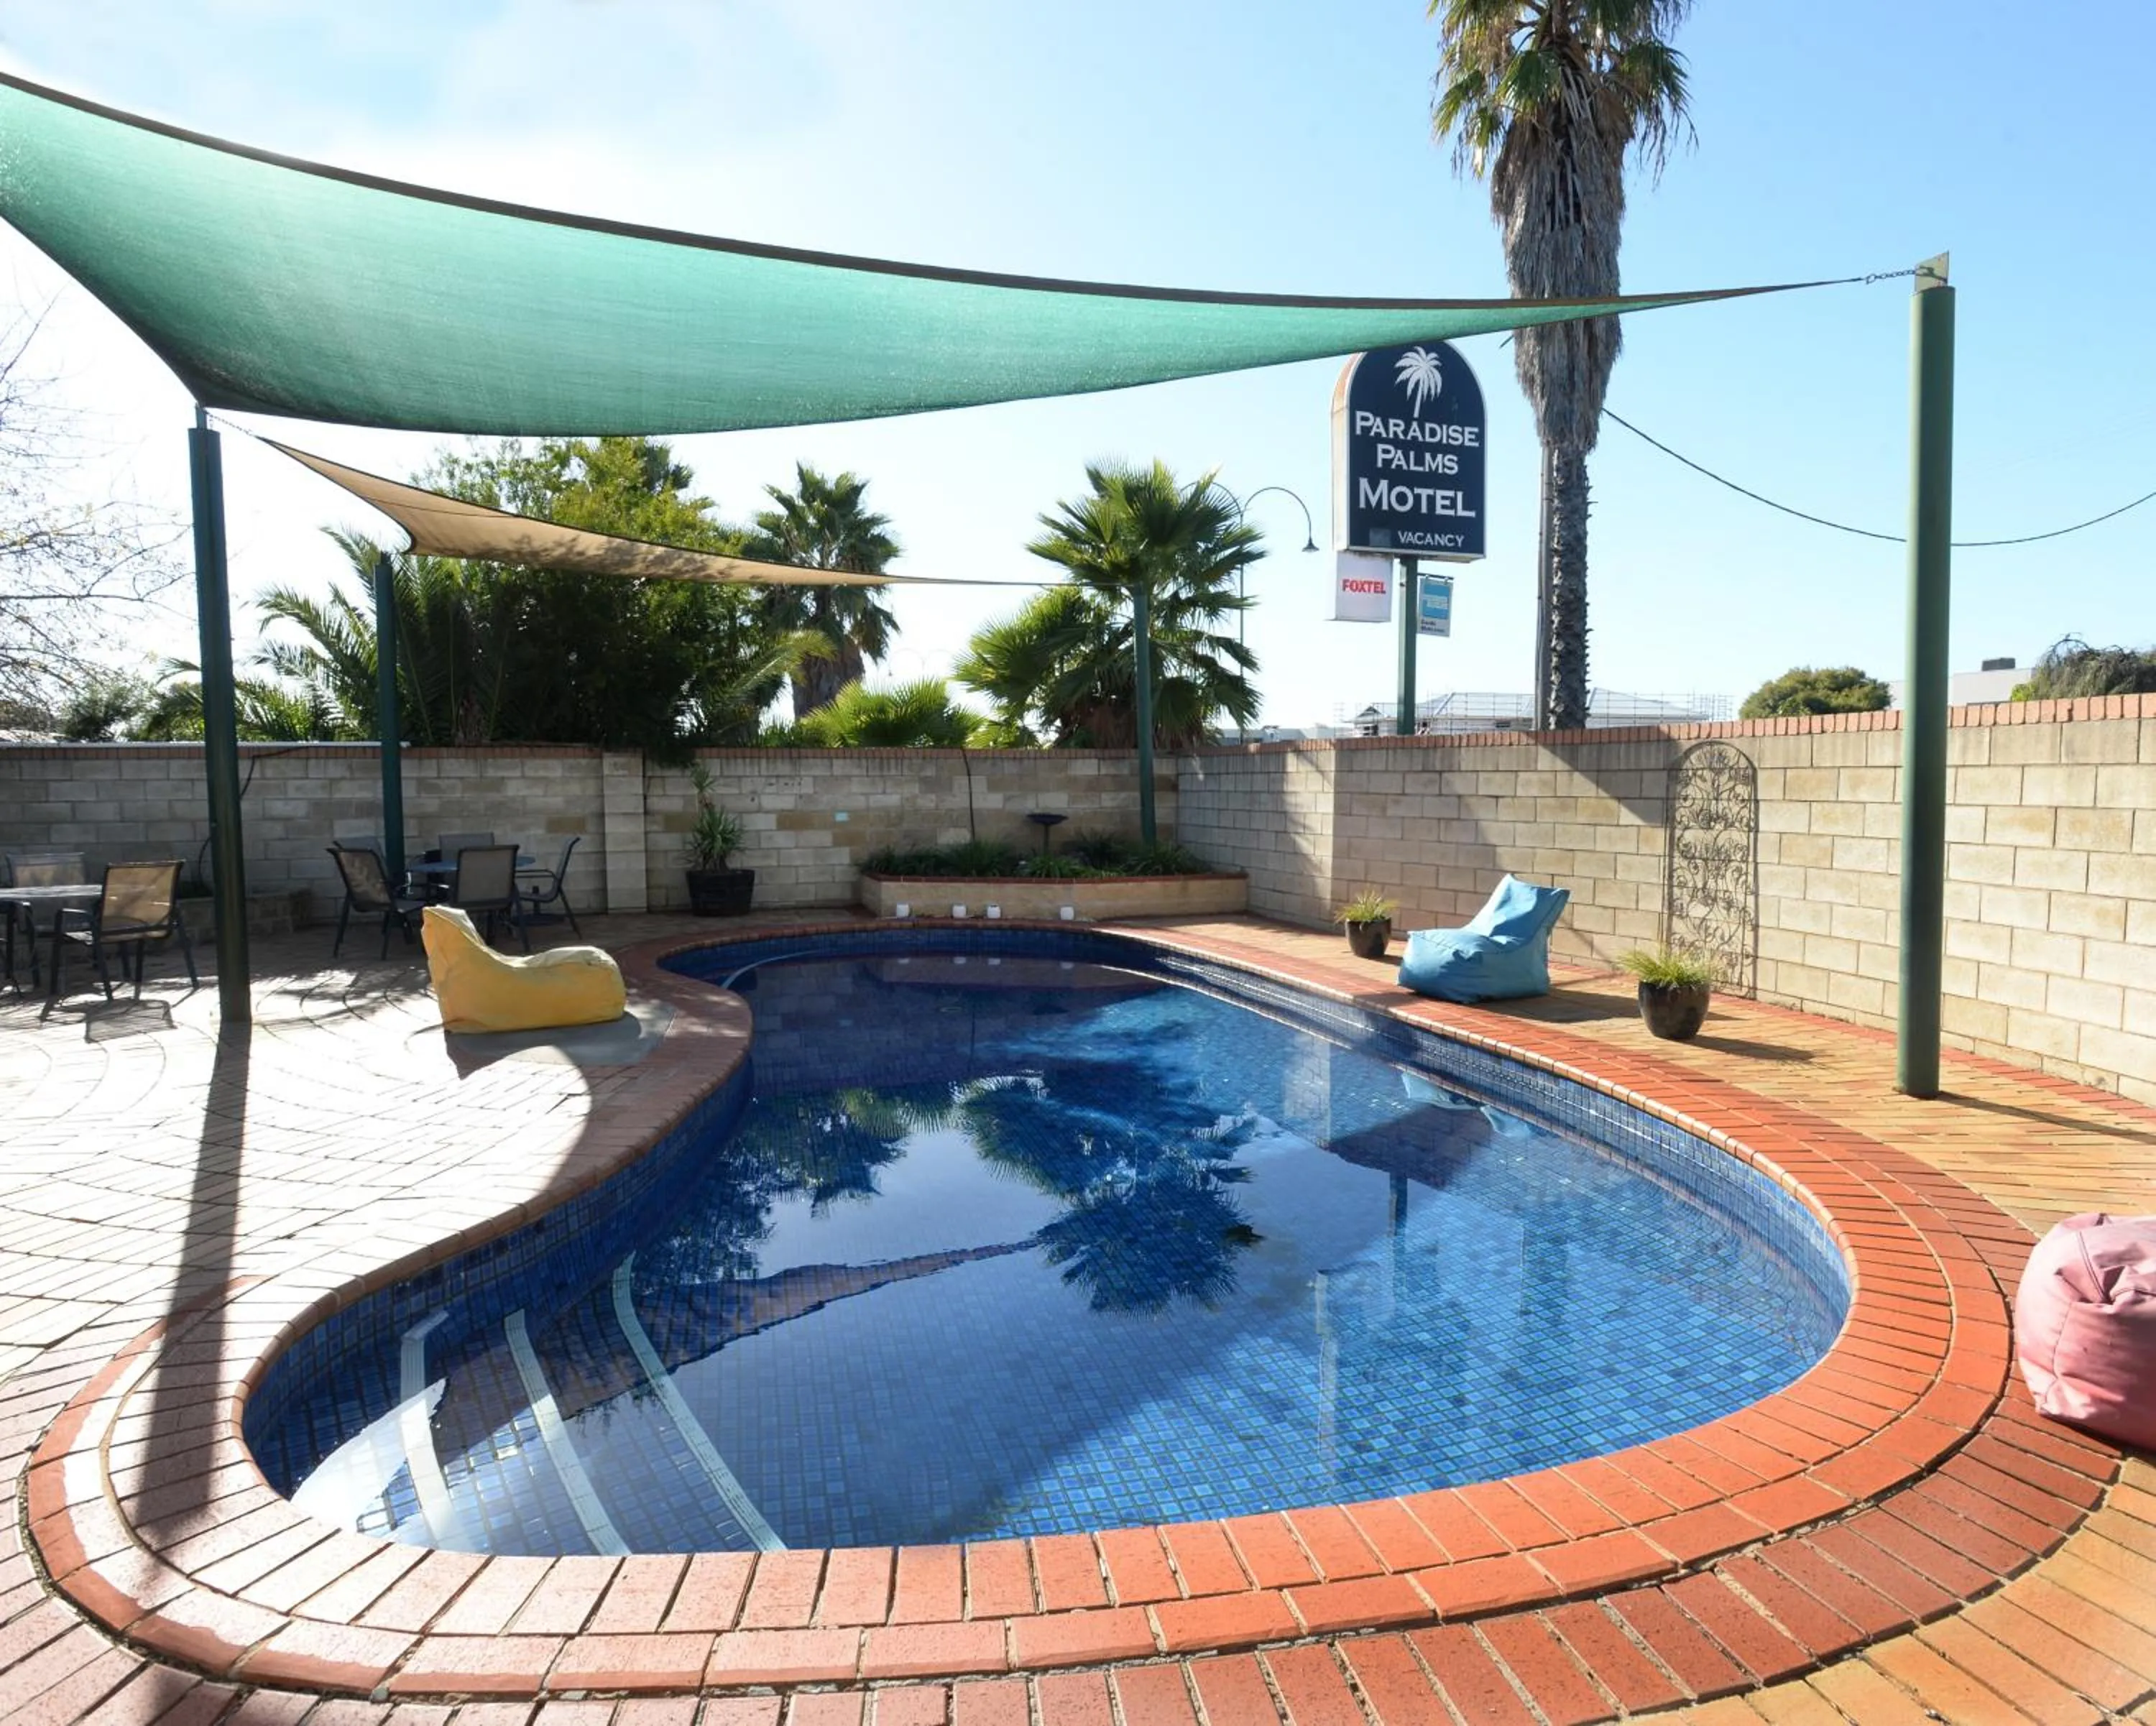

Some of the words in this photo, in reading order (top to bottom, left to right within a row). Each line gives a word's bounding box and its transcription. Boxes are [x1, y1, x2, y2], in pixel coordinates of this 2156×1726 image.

[1355, 410, 1479, 447] PARADISE
[1377, 443, 1458, 475] PALMS
[1359, 477, 1475, 517] MOTEL
[1398, 530, 1464, 548] VACANCY
[1342, 579, 1386, 594] FOXTEL
